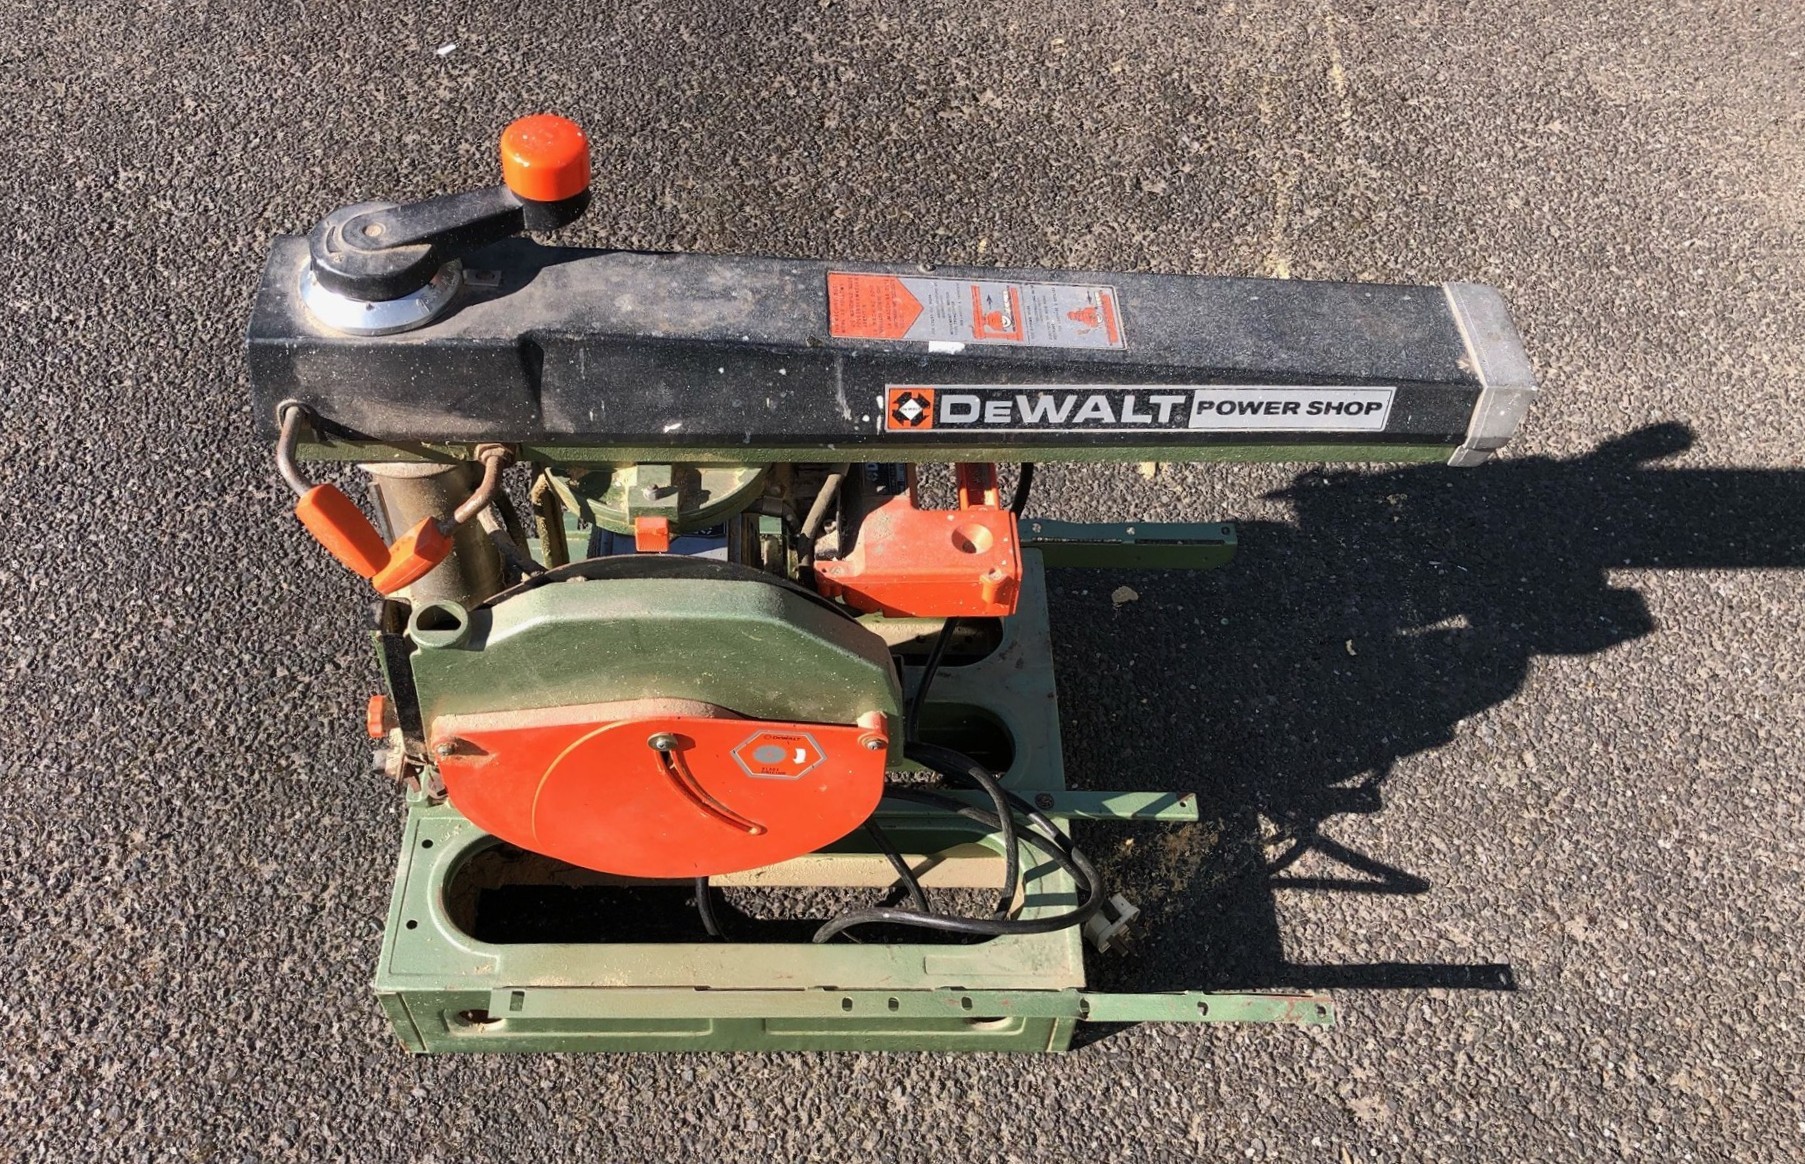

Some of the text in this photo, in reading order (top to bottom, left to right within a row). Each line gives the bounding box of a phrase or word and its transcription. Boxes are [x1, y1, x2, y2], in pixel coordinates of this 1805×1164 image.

[939, 394, 1383, 424] DEWALT POWER SHOP
